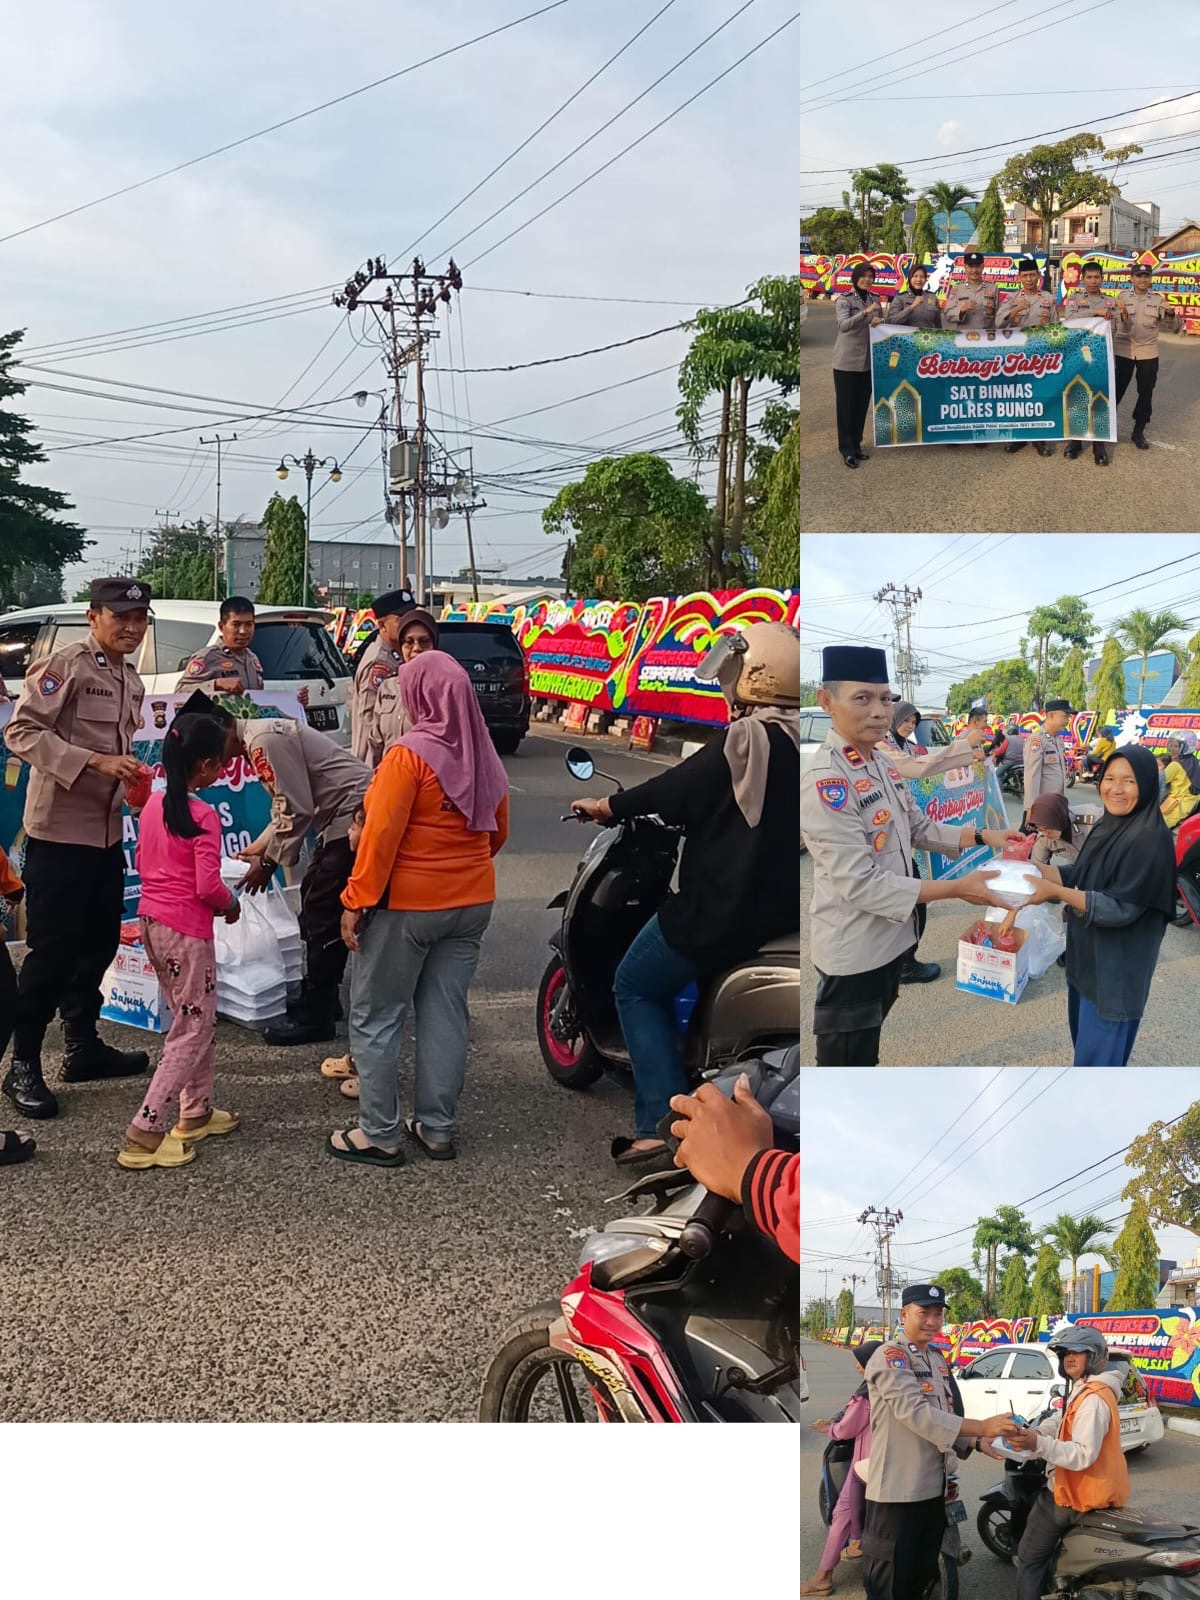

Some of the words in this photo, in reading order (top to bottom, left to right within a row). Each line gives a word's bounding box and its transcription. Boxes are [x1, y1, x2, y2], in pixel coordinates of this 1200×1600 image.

[917, 353, 1002, 381] Berbagi
[1001, 351, 1063, 378] Takjil
[950, 386, 976, 400] SAT
[978, 383, 1033, 399] BINMAS
[940, 402, 993, 419] POLRES
[996, 401, 1043, 417] BUNGO
[110, 986, 144, 1008] Sajuak
